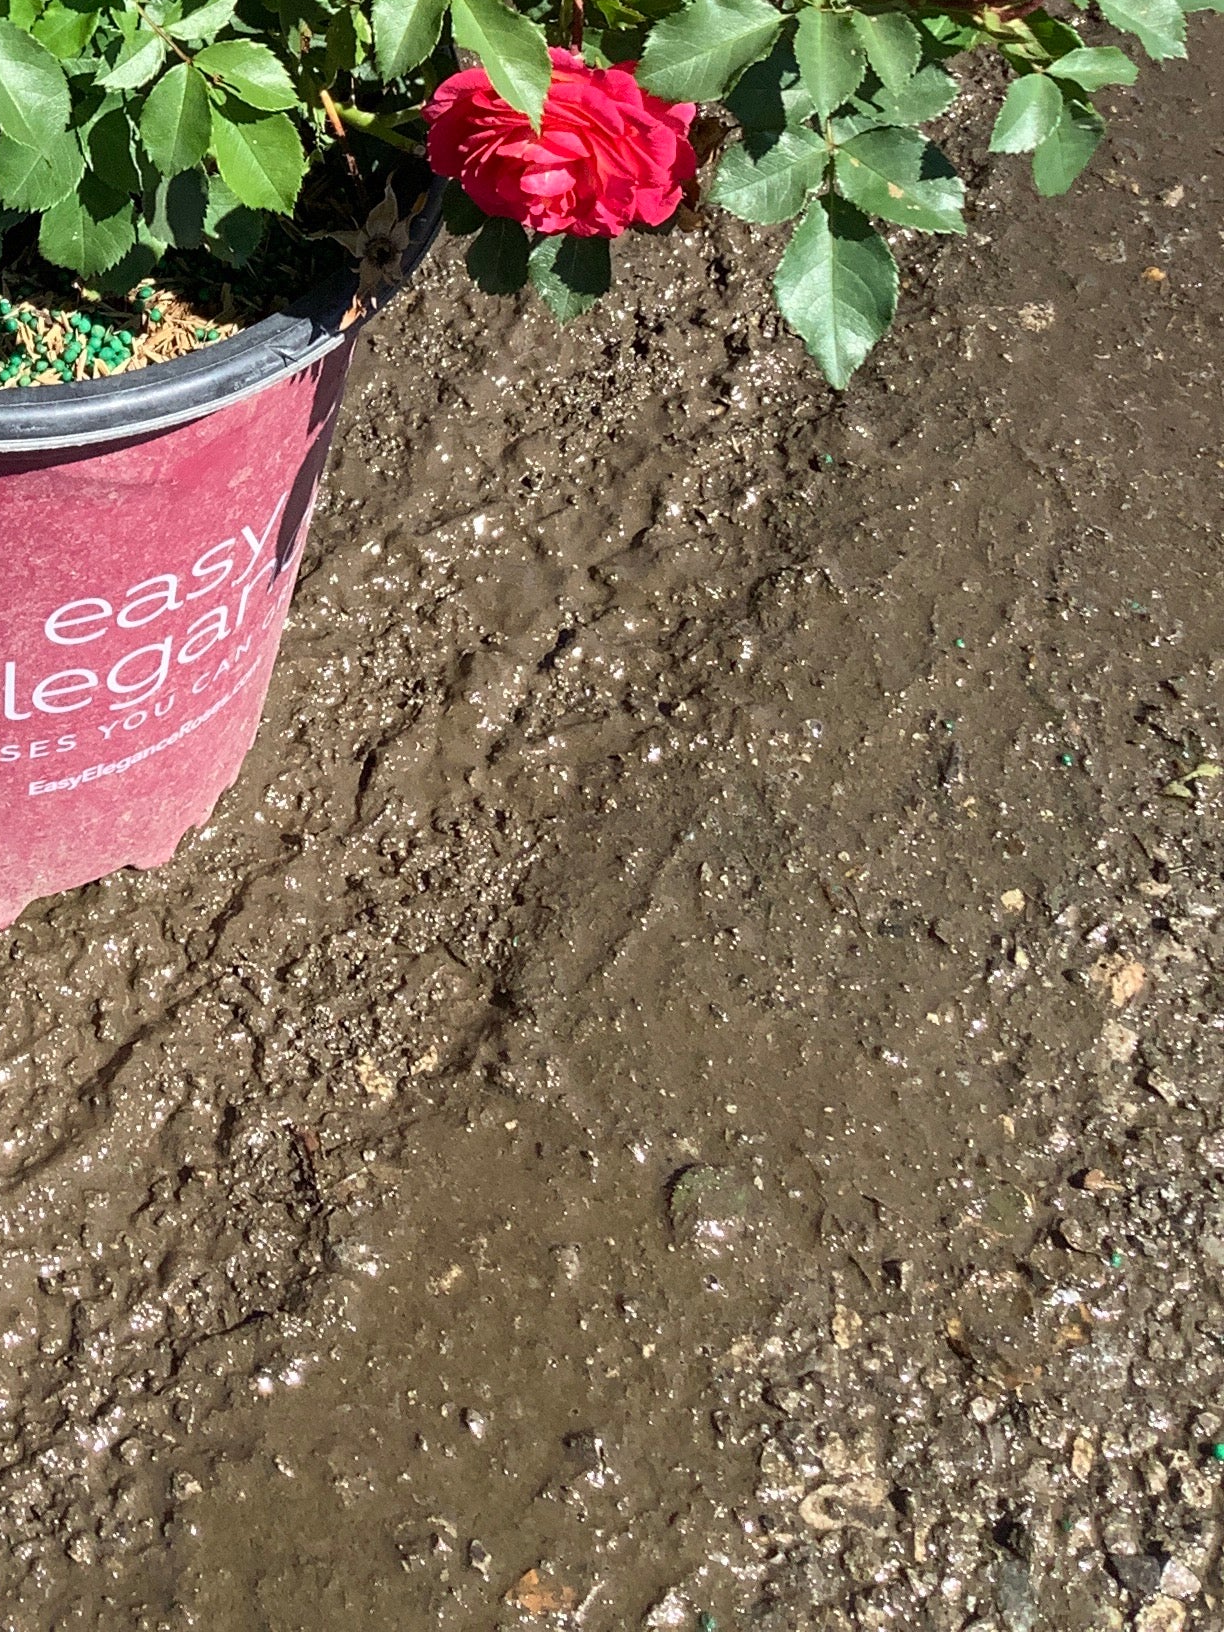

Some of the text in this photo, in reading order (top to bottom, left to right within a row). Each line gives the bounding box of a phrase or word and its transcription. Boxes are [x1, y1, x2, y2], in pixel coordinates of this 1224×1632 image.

[44, 491, 289, 645] easy
[97, 694, 176, 741] YOU
[191, 635, 252, 695] CAN
